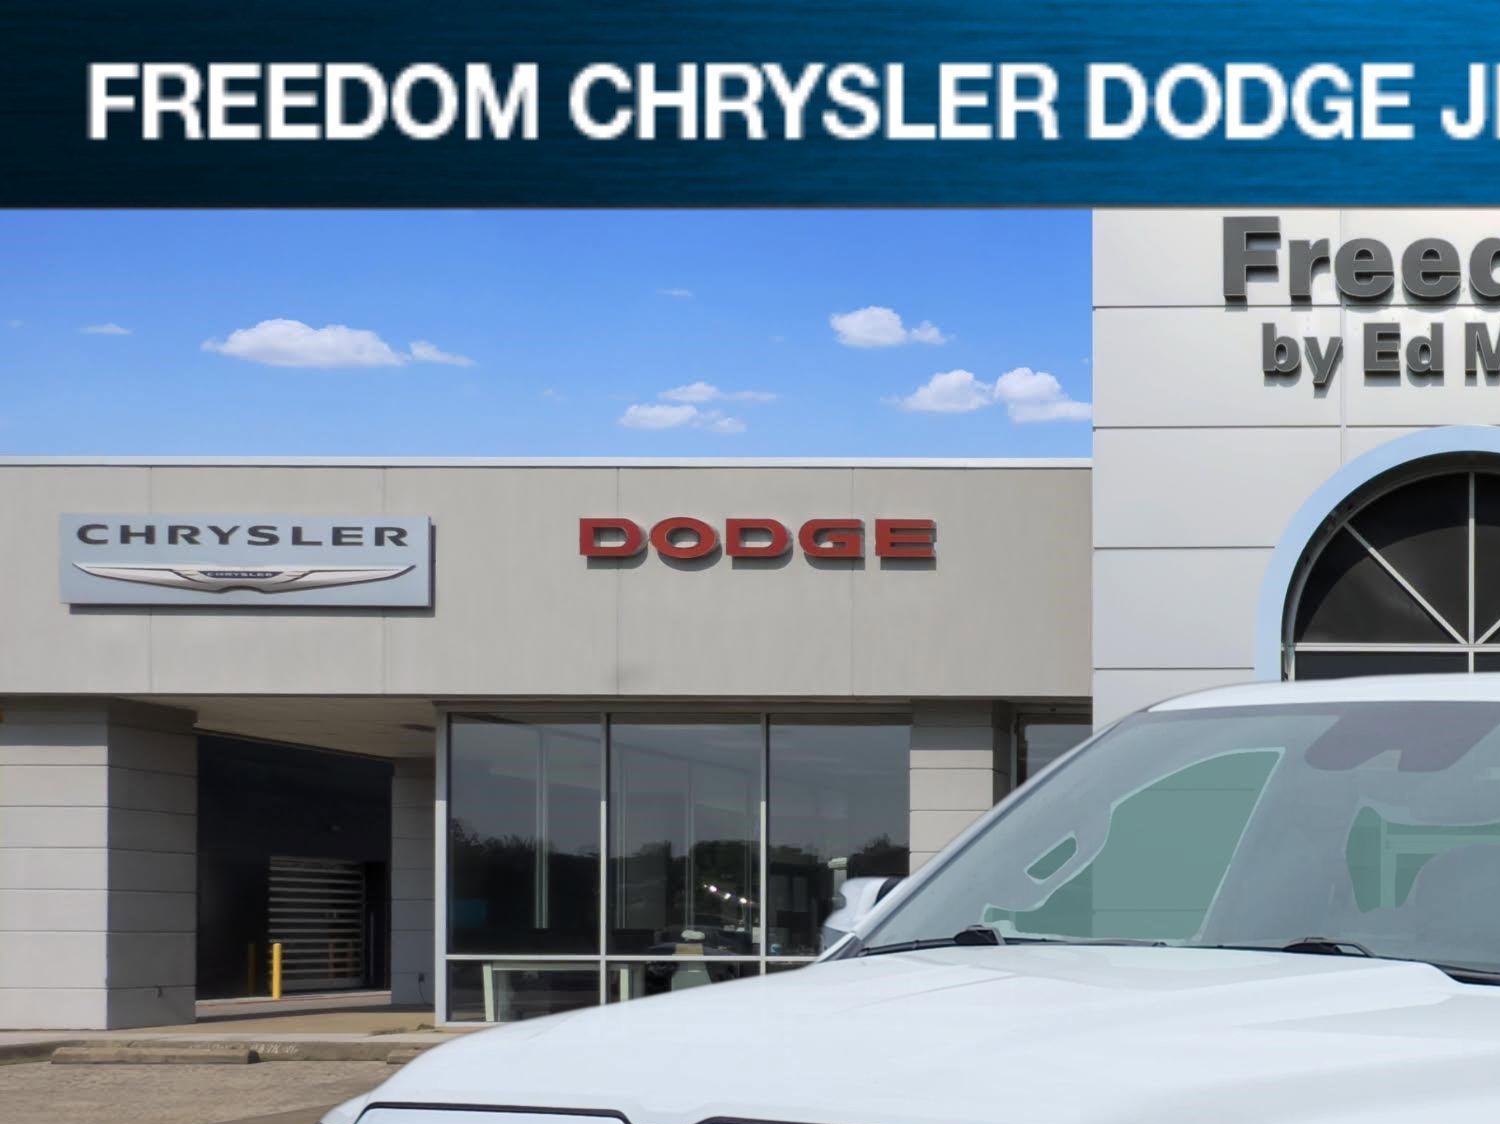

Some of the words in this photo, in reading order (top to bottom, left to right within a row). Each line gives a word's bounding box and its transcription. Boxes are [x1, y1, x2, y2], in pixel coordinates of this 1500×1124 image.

[1262, 321, 1343, 386] by
[1363, 321, 1445, 375] Ed
[75, 522, 410, 549] CHRYSLER
[578, 517, 937, 561] DODGE
